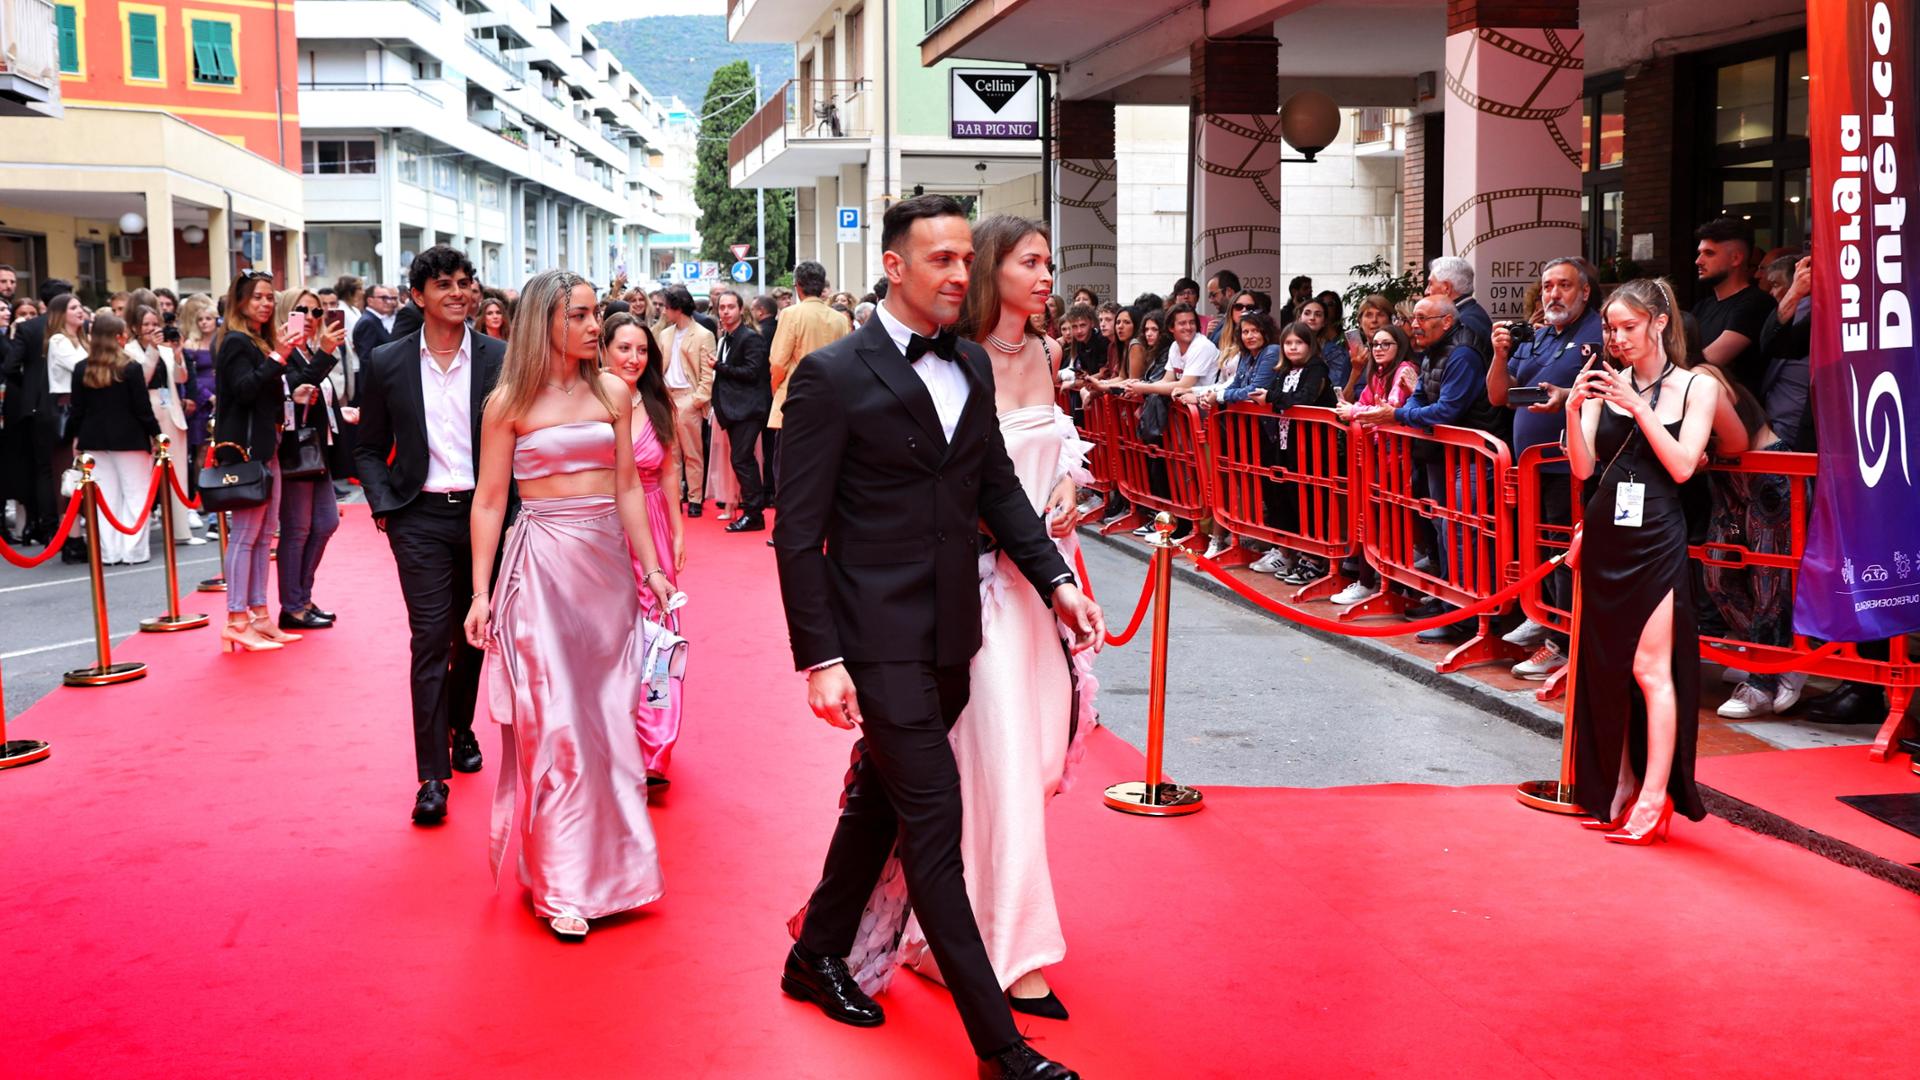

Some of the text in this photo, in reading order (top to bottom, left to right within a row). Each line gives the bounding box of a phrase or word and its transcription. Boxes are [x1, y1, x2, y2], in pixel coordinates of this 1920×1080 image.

[975, 79, 1015, 92] Cellini
[957, 123, 1032, 136] BAR PIC NIC
[843, 211, 855, 226] P
[686, 263, 697, 278] P
[1491, 261, 1547, 278] RIFF 20
[1242, 277, 1272, 289] 2023
[1490, 286, 1507, 299] 09
[1491, 302, 1507, 315] 14
